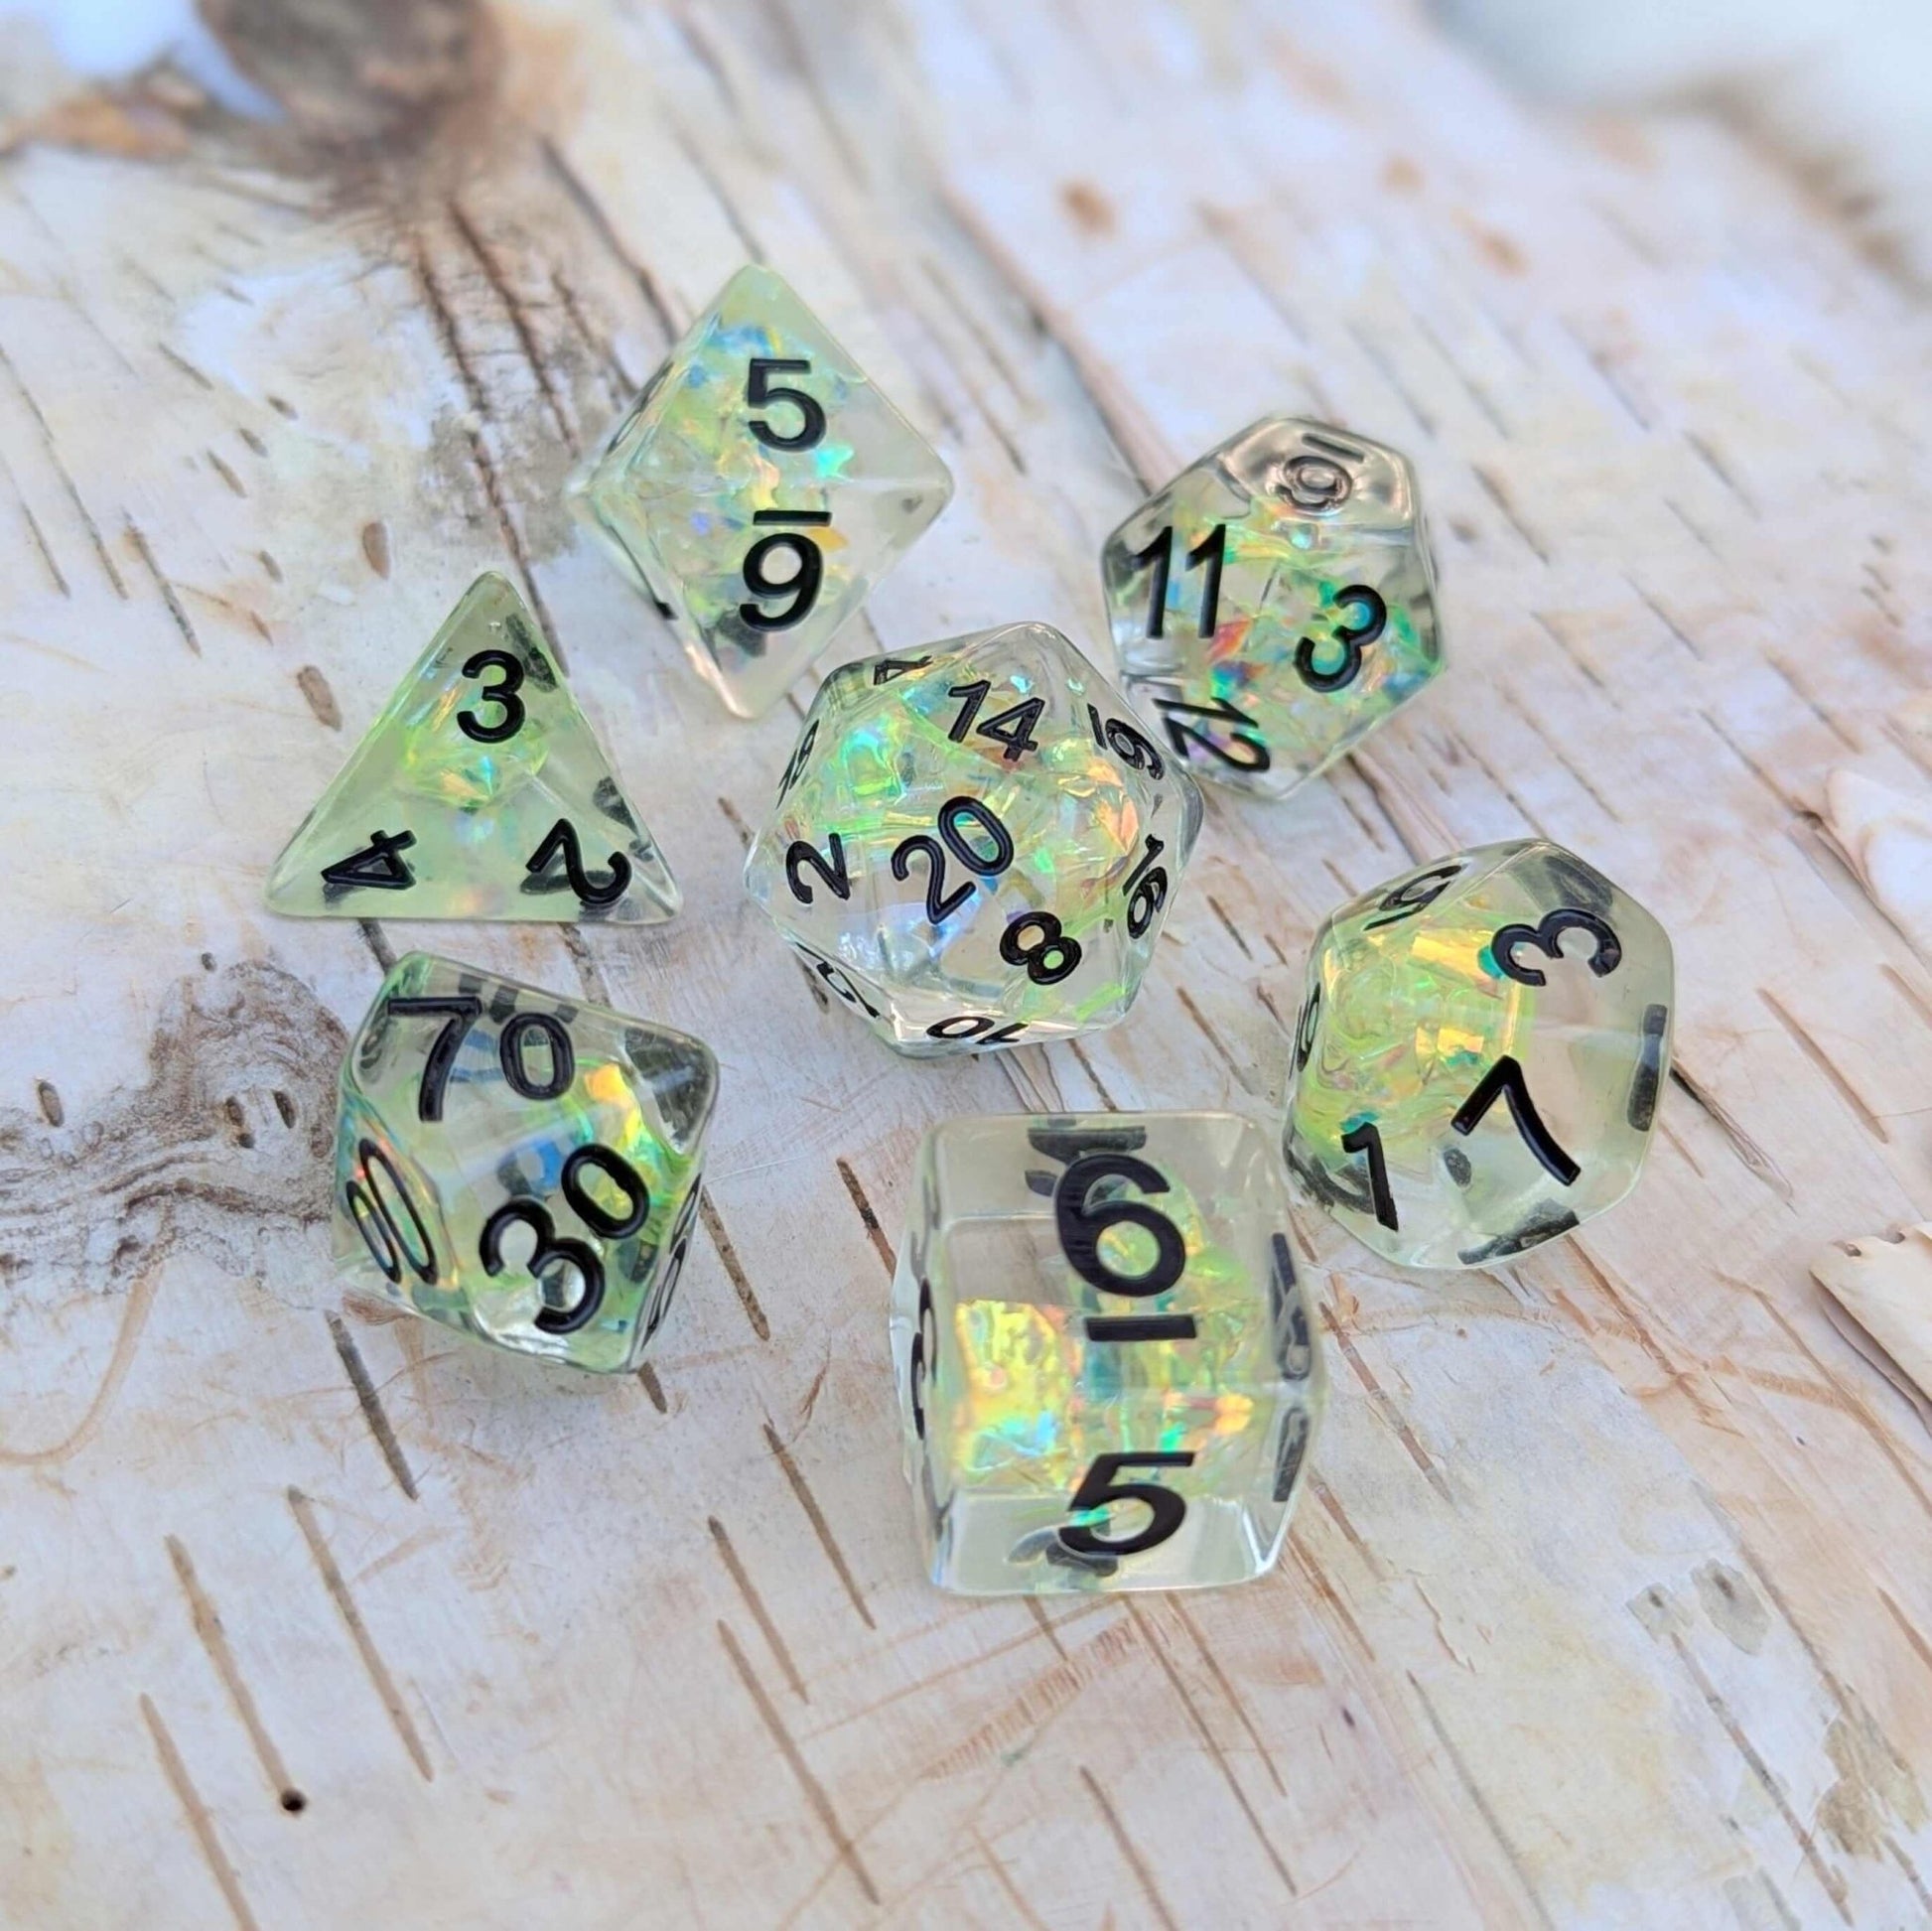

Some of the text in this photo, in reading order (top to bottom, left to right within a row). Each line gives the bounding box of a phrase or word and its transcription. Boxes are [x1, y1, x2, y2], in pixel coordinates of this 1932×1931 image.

[748, 358, 827, 453] 5
[1132, 523, 1227, 640] 11
[1294, 584, 1388, 693] 3
[457, 648, 526, 744] 3
[947, 679, 1046, 762] 14
[321, 829, 417, 891] 4
[525, 817, 632, 905] 2
[785, 832, 852, 904] 2
[891, 795, 1015, 925] 20
[999, 910, 1083, 985] 8
[1491, 908, 1622, 987] 3
[387, 996, 576, 1123] 70
[1450, 1054, 1582, 1187] 7
[1340, 1121, 1400, 1232] 1
[479, 1144, 651, 1335] 30
[1057, 1450, 1196, 1557] 5
